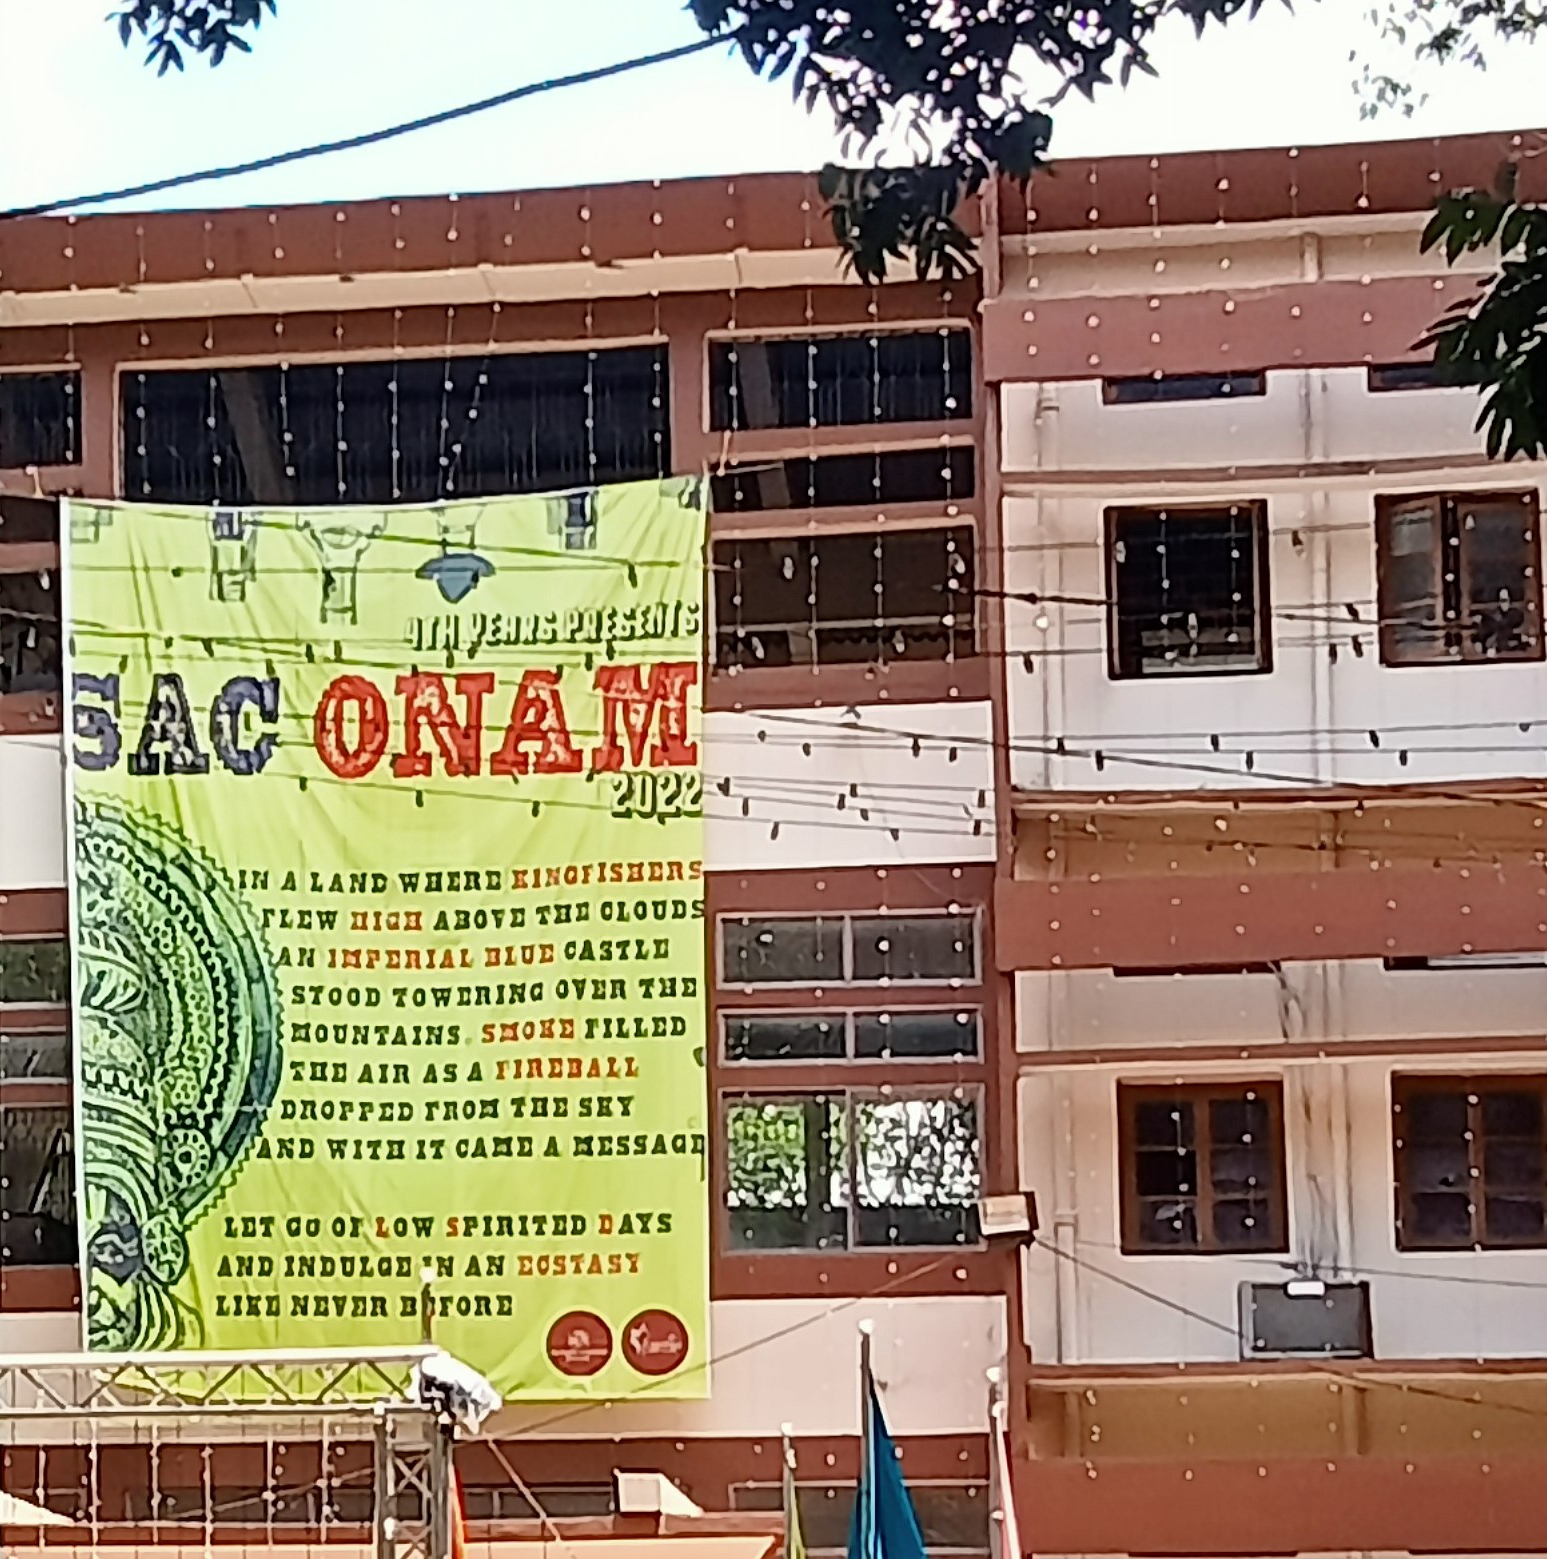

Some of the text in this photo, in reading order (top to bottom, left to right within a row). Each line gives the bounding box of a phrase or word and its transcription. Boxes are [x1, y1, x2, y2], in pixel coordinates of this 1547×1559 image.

[72, 661, 698, 779] SAC ONAM
[611, 771, 703, 818] 2022
[239, 860, 703, 893] IN A LAND WHERE KINGFISHERS
[262, 899, 704, 931] FLEW HIGH ABOVE THE CLOUDS
[279, 938, 669, 969] AN IMPERIAL BLUE CASTLE
[291, 977, 697, 1007] STOOD TOWERING OVER THE
[481, 1018, 575, 1043] SMOKE
[584, 1016, 686, 1039] FILLED
[290, 1057, 639, 1084] THE AIR AS A FIREBALL
[280, 1095, 635, 1121] DROPPED FROM THE SKY
[256, 1137, 315, 1159] AND
[326, 1138, 405, 1160] WITH
[416, 1138, 445, 1160] IT
[456, 1136, 533, 1158] CAME
[543, 1136, 561, 1157] A
[225, 1212, 673, 1238] LET GO OF LOW SPIRITED DAYS
[217, 1255, 274, 1278] AND
[284, 1255, 411, 1278] INDULGE
[465, 1254, 505, 1277] AN
[517, 1252, 641, 1276] ECSTASY
[216, 1295, 513, 1317] LIKE NEVER BFORE
